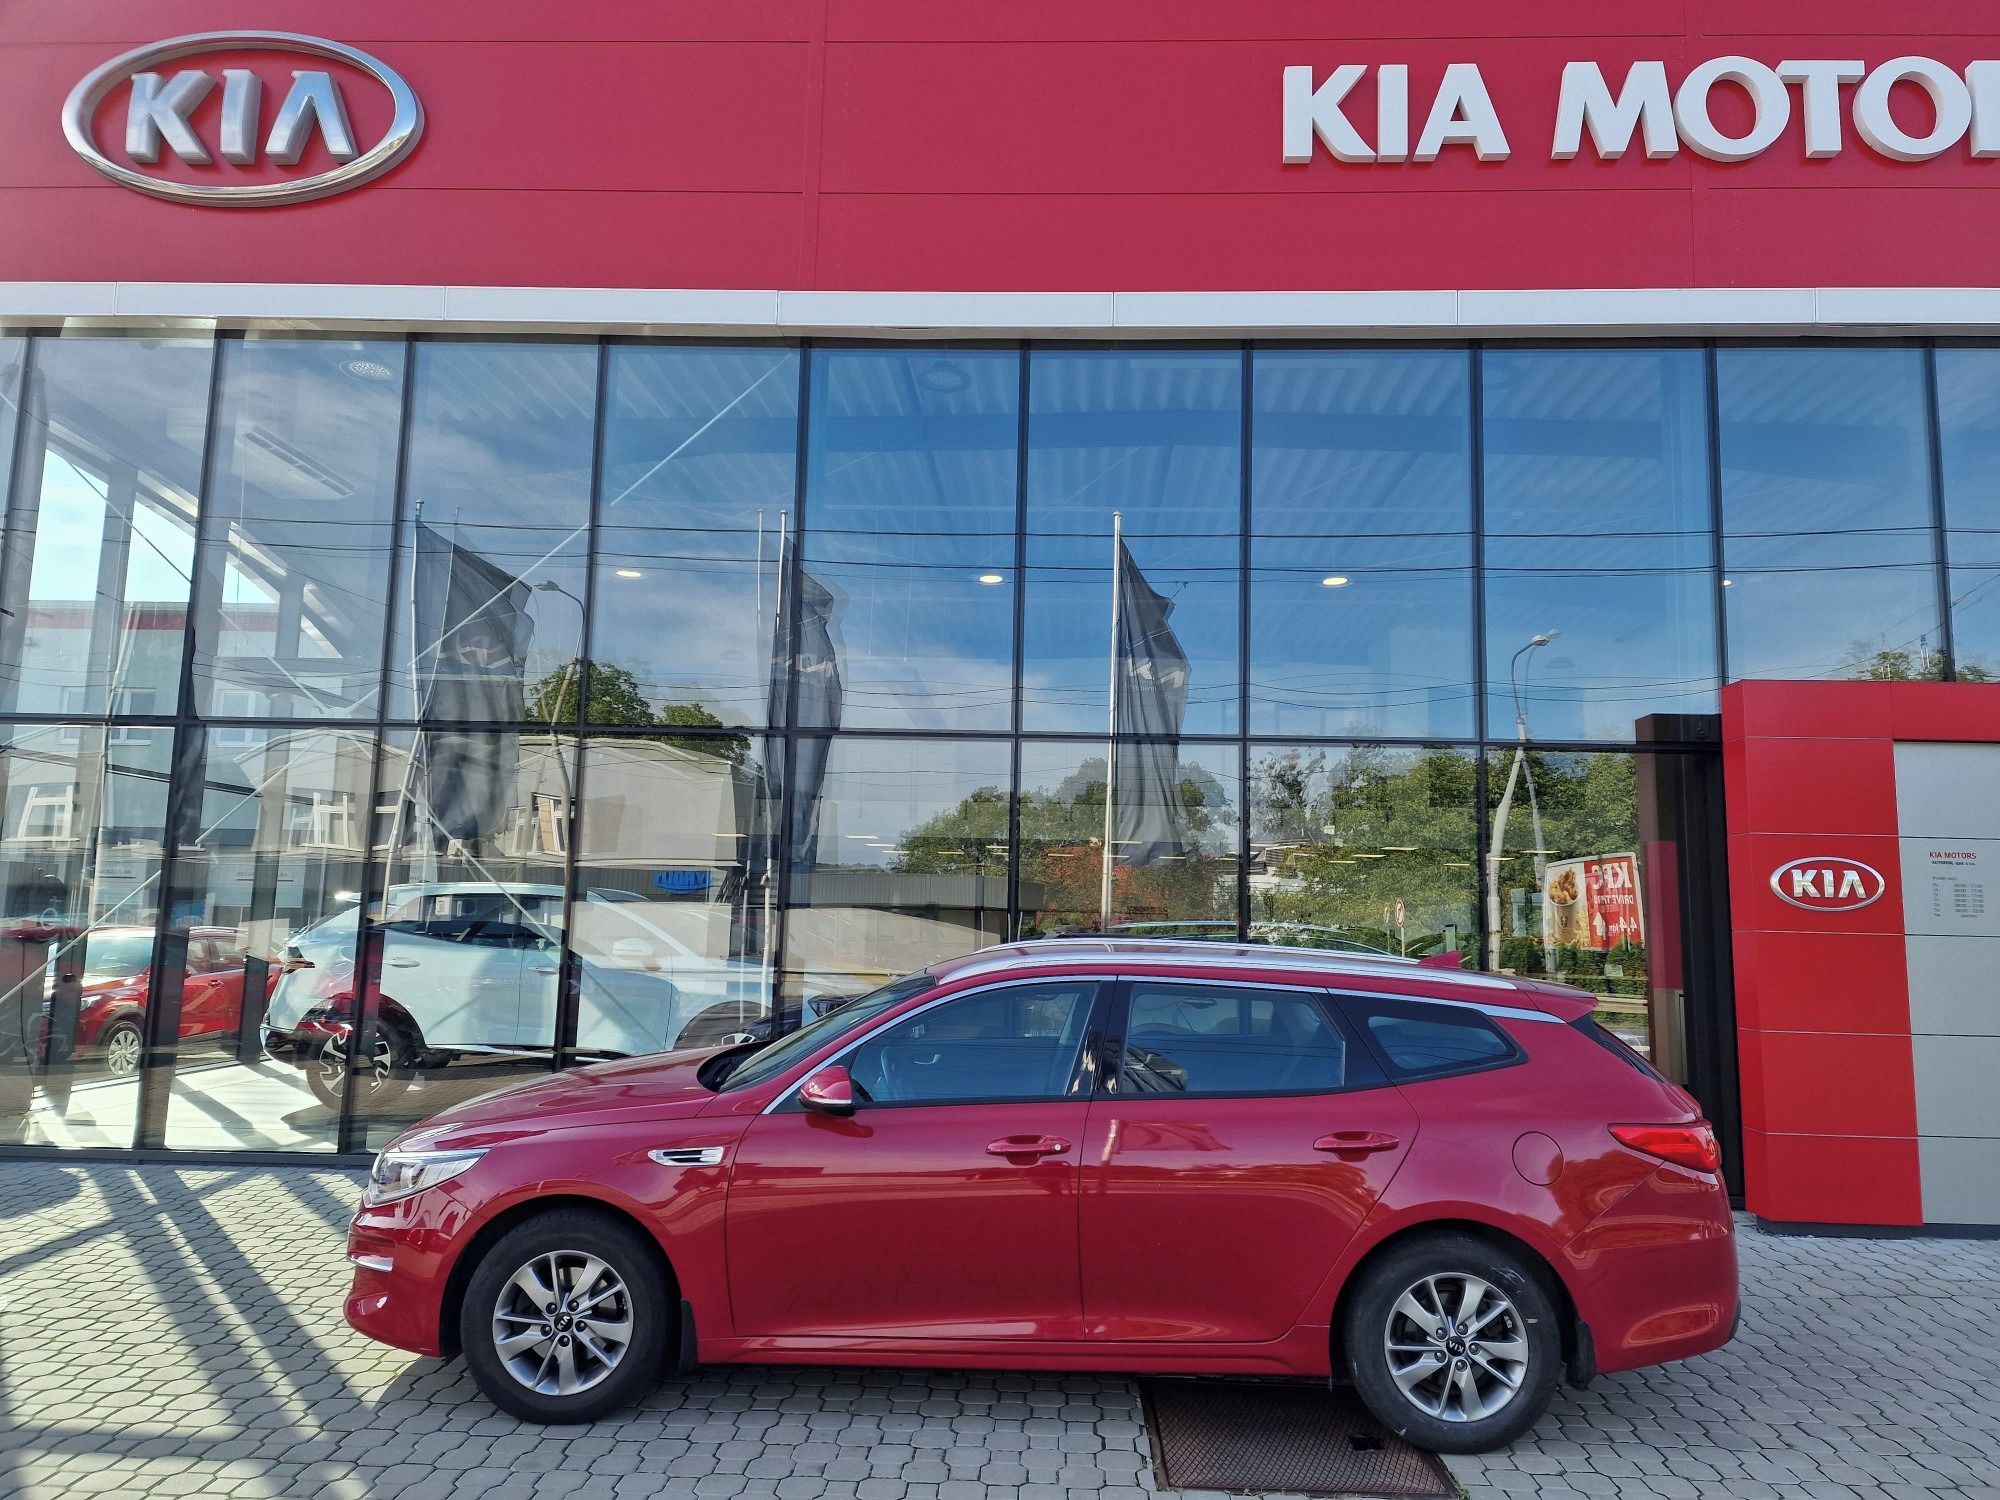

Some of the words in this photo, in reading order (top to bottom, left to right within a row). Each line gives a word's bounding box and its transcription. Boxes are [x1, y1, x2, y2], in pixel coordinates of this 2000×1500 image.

[125, 69, 359, 165] KIA
[1282, 63, 1510, 164] KIA
[1929, 851, 1943, 859] KIA
[1945, 851, 1977, 860] MOTORS
[1791, 869, 1867, 899] KIA
[556, 1315, 570, 1330] KIA
[1449, 1340, 1464, 1353] KIA
